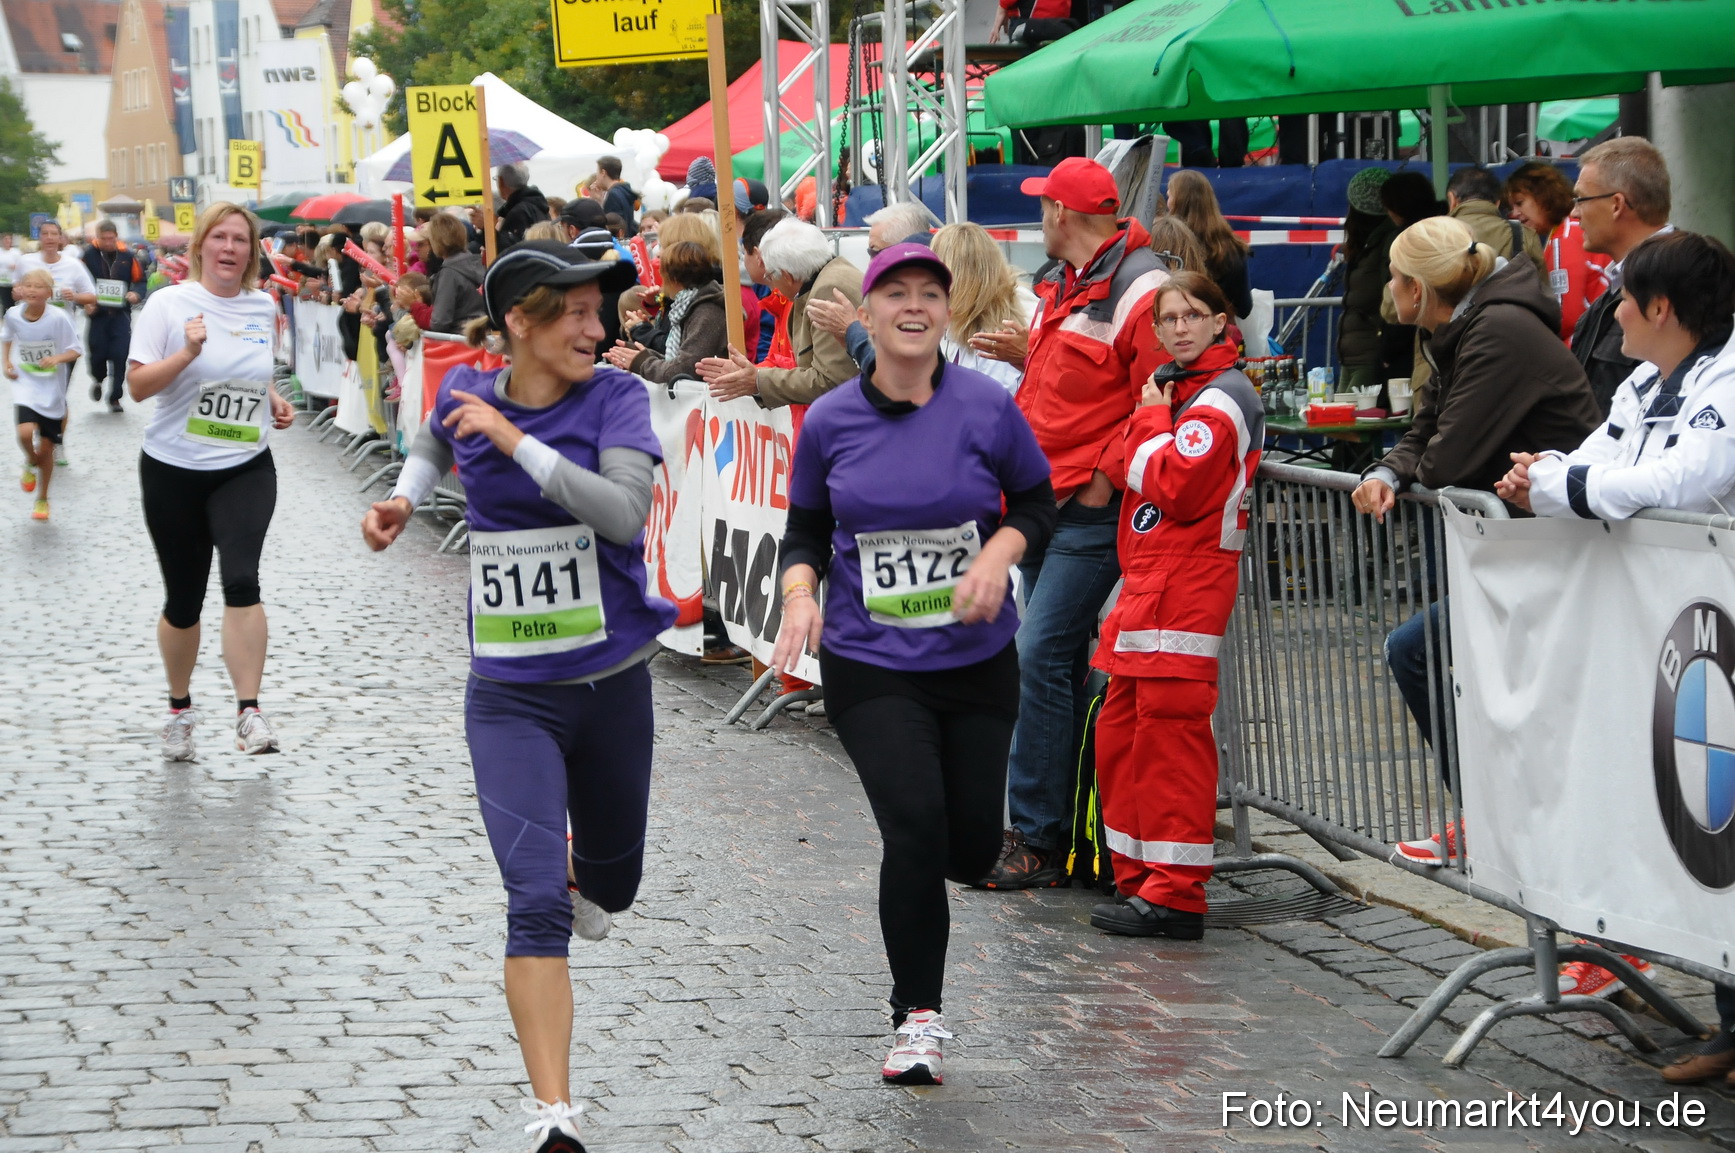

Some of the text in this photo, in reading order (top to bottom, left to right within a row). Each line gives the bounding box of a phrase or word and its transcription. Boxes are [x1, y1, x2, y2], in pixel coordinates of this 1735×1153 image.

[612, 9, 658, 32] lauf
[416, 90, 477, 113] Block
[233, 141, 258, 152] Block
[429, 122, 474, 180] A
[237, 154, 254, 178] B
[179, 212, 190, 226] C
[147, 224, 156, 235] D
[98, 285, 120, 296] 5132
[224, 383, 258, 395] Neumarkt
[198, 392, 261, 422] 5017
[207, 425, 242, 439] Sandra
[1182, 423, 1210, 440] DEUTSCHES
[471, 541, 570, 556] PARTL Neumarkt
[860, 535, 957, 548] PARTL Neumarkt
[874, 547, 970, 589] 5122
[481, 557, 581, 608] 5141
[901, 594, 951, 615] Karina
[512, 620, 558, 638] Petra
[1660, 608, 1735, 693] BM
